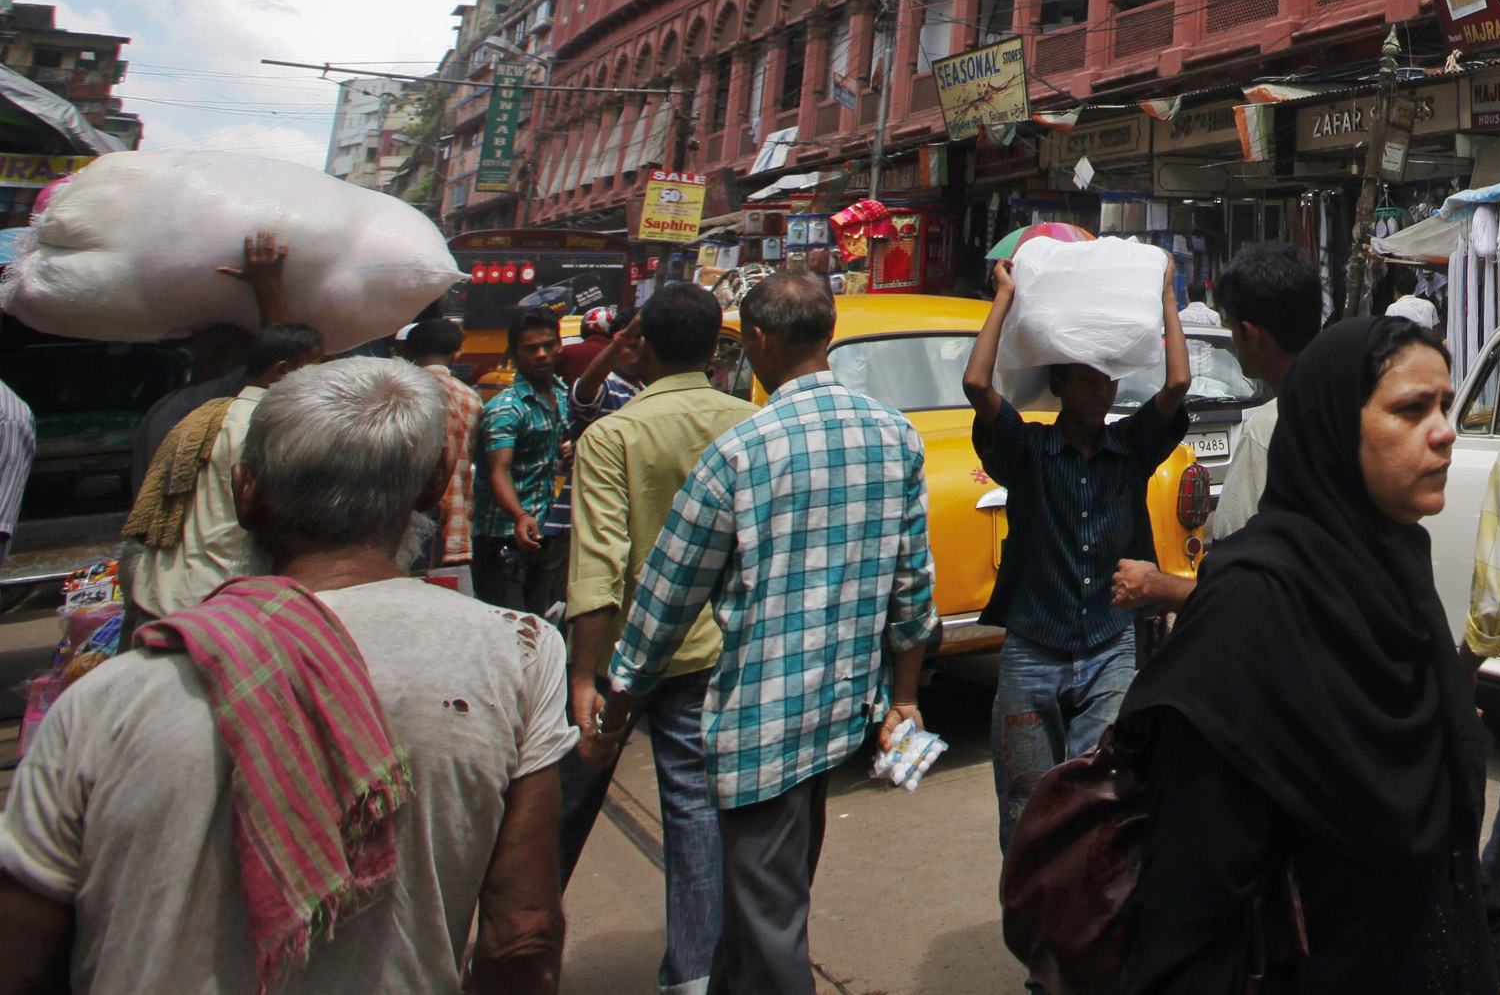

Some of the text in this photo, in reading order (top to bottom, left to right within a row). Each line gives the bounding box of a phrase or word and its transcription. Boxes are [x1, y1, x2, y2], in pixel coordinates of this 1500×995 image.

[496, 65, 525, 77] NEW
[937, 48, 1022, 90] SEASONAL STORES
[493, 77, 517, 158] PUNJABI
[1313, 109, 1362, 138] ZAFAR
[652, 170, 707, 185] SALE
[643, 217, 697, 232] Saphire
[1198, 439, 1225, 452] 9485
